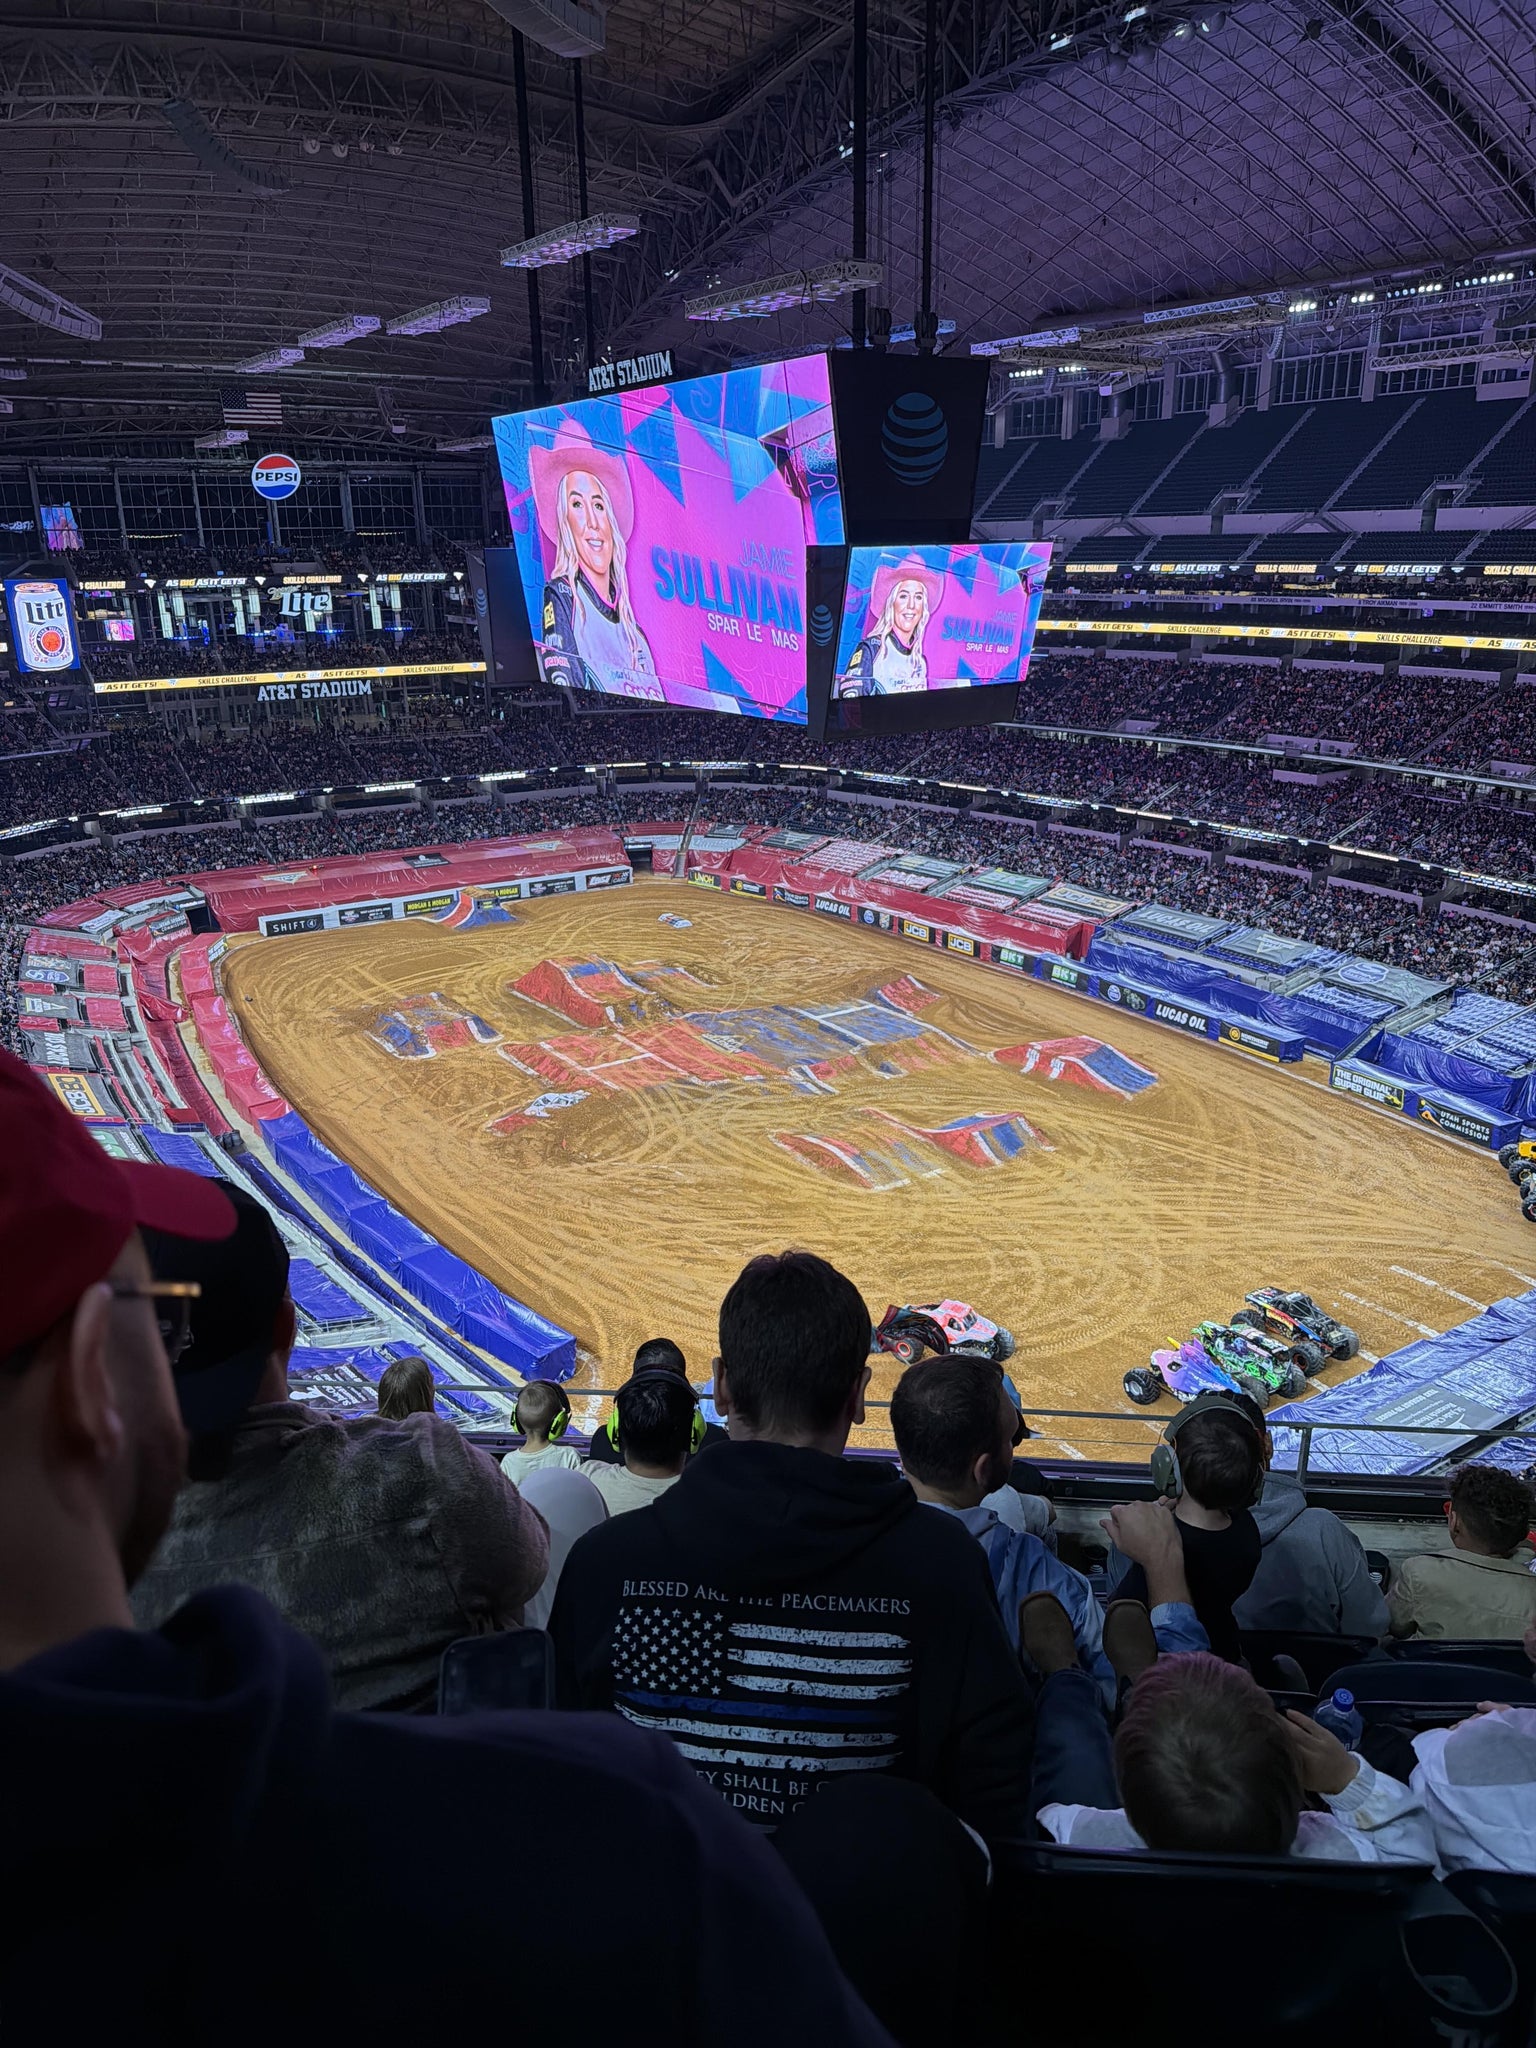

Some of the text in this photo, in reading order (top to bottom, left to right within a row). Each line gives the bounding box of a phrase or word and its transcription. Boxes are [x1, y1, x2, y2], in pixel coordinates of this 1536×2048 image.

[588, 350, 673, 392] AT&T STADIUM
[255, 472, 298, 482] PEPSI
[738, 540, 797, 580] JAMIE
[1150, 564, 1160, 572] AS
[1175, 564, 1186, 572] AS
[1278, 564, 1317, 573] CHALLENGE
[1354, 565, 1368, 573] AS
[1385, 565, 1399, 573] AS
[1399, 565, 1411, 573] IT
[1412, 564, 1443, 574] GETS!
[1484, 565, 1512, 575] SKILLS
[166, 579, 179, 587] AS
[196, 578, 209, 587] AS
[652, 544, 804, 635] SULLIVAN
[22, 601, 64, 626] Lite
[279, 592, 330, 617] Lite
[708, 614, 799, 652] SPAR LE MAS
[940, 615, 1014, 647] SULLIVAN
[1167, 625, 1222, 634] SKILLS CHALLENGE
[1310, 631, 1336, 639] GETS!
[1376, 634, 1443, 644] SKILLS CHALLENGE
[422, 665, 455, 673] CHALLENGE
[198, 674, 257, 685] SKILLS CHALLENGE
[257, 680, 372, 702] AT&T STADIUM
[407, 902, 427, 911] MORGAN
[432, 898, 451, 907] MORGAN
[816, 899, 851, 917] LUCAS OIL
[905, 924, 928, 938] JCB
[950, 937, 972, 952] JCB
[1000, 948, 1024, 965] BKT
[1052, 965, 1078, 982] BKT
[1156, 1003, 1207, 1032] LUCAS OIL
[46, 1044, 70, 1066] LUCAS
[1334, 1078, 1385, 1102] SUPER GLUE
[1336, 1069, 1390, 1095] THE ORIGINAL
[1440, 1110, 1490, 1135] UTAH SPORTS
[1440, 1118, 1490, 1142] COMMISSION
[622, 1580, 689, 1598] BLESSED
[781, 1592, 911, 1616] PEACEMAKERS
[723, 1772, 782, 1794] SHALL
[789, 1780, 809, 1796] BE
